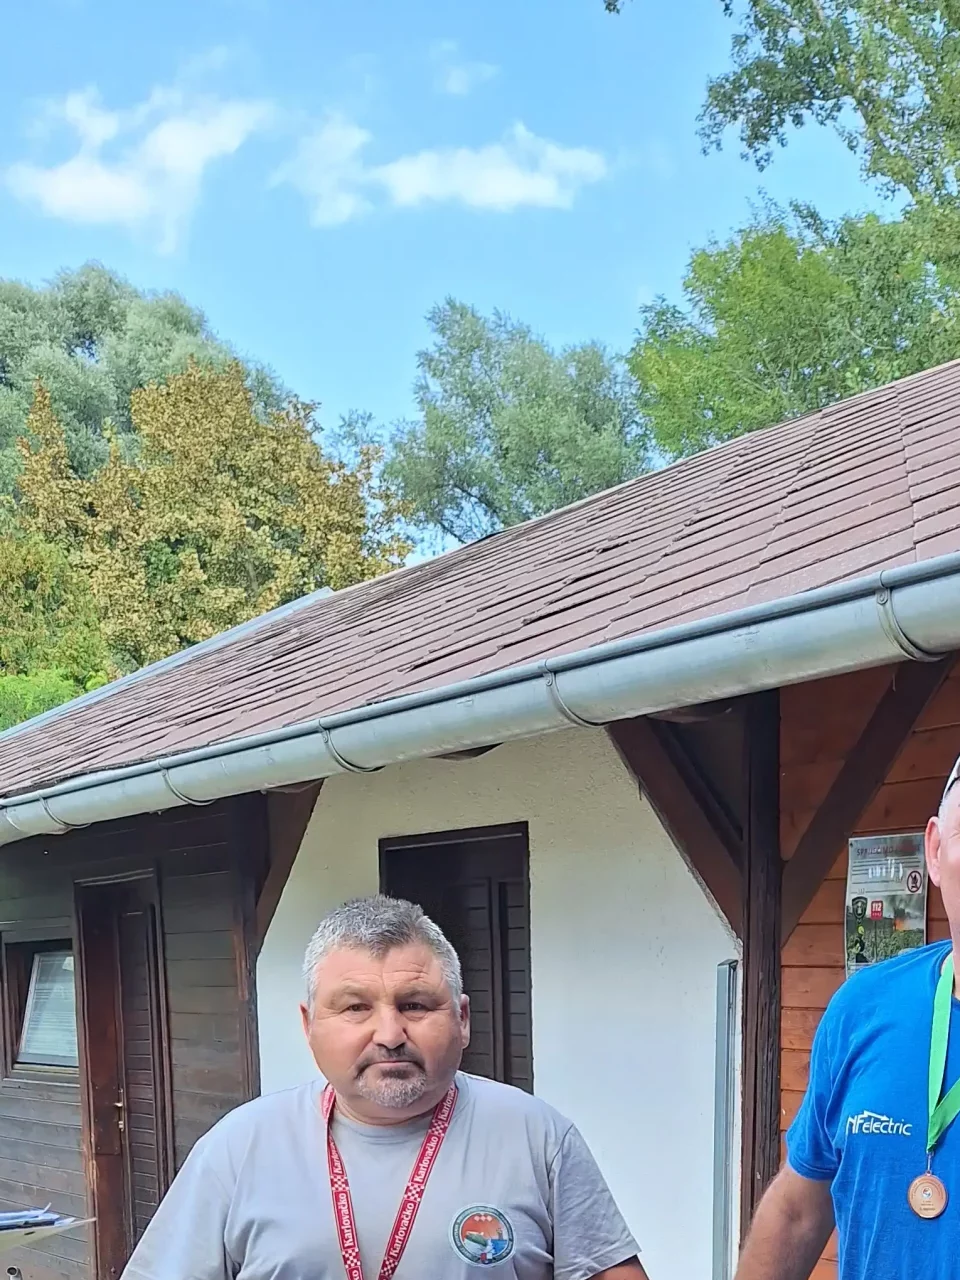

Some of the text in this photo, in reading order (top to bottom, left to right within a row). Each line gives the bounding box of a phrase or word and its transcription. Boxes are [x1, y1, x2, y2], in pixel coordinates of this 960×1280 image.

[414, 1136, 438, 1183] Karlovačko
[338, 1192, 355, 1248] Karlovačko
[390, 1202, 414, 1257] Karlovačko
